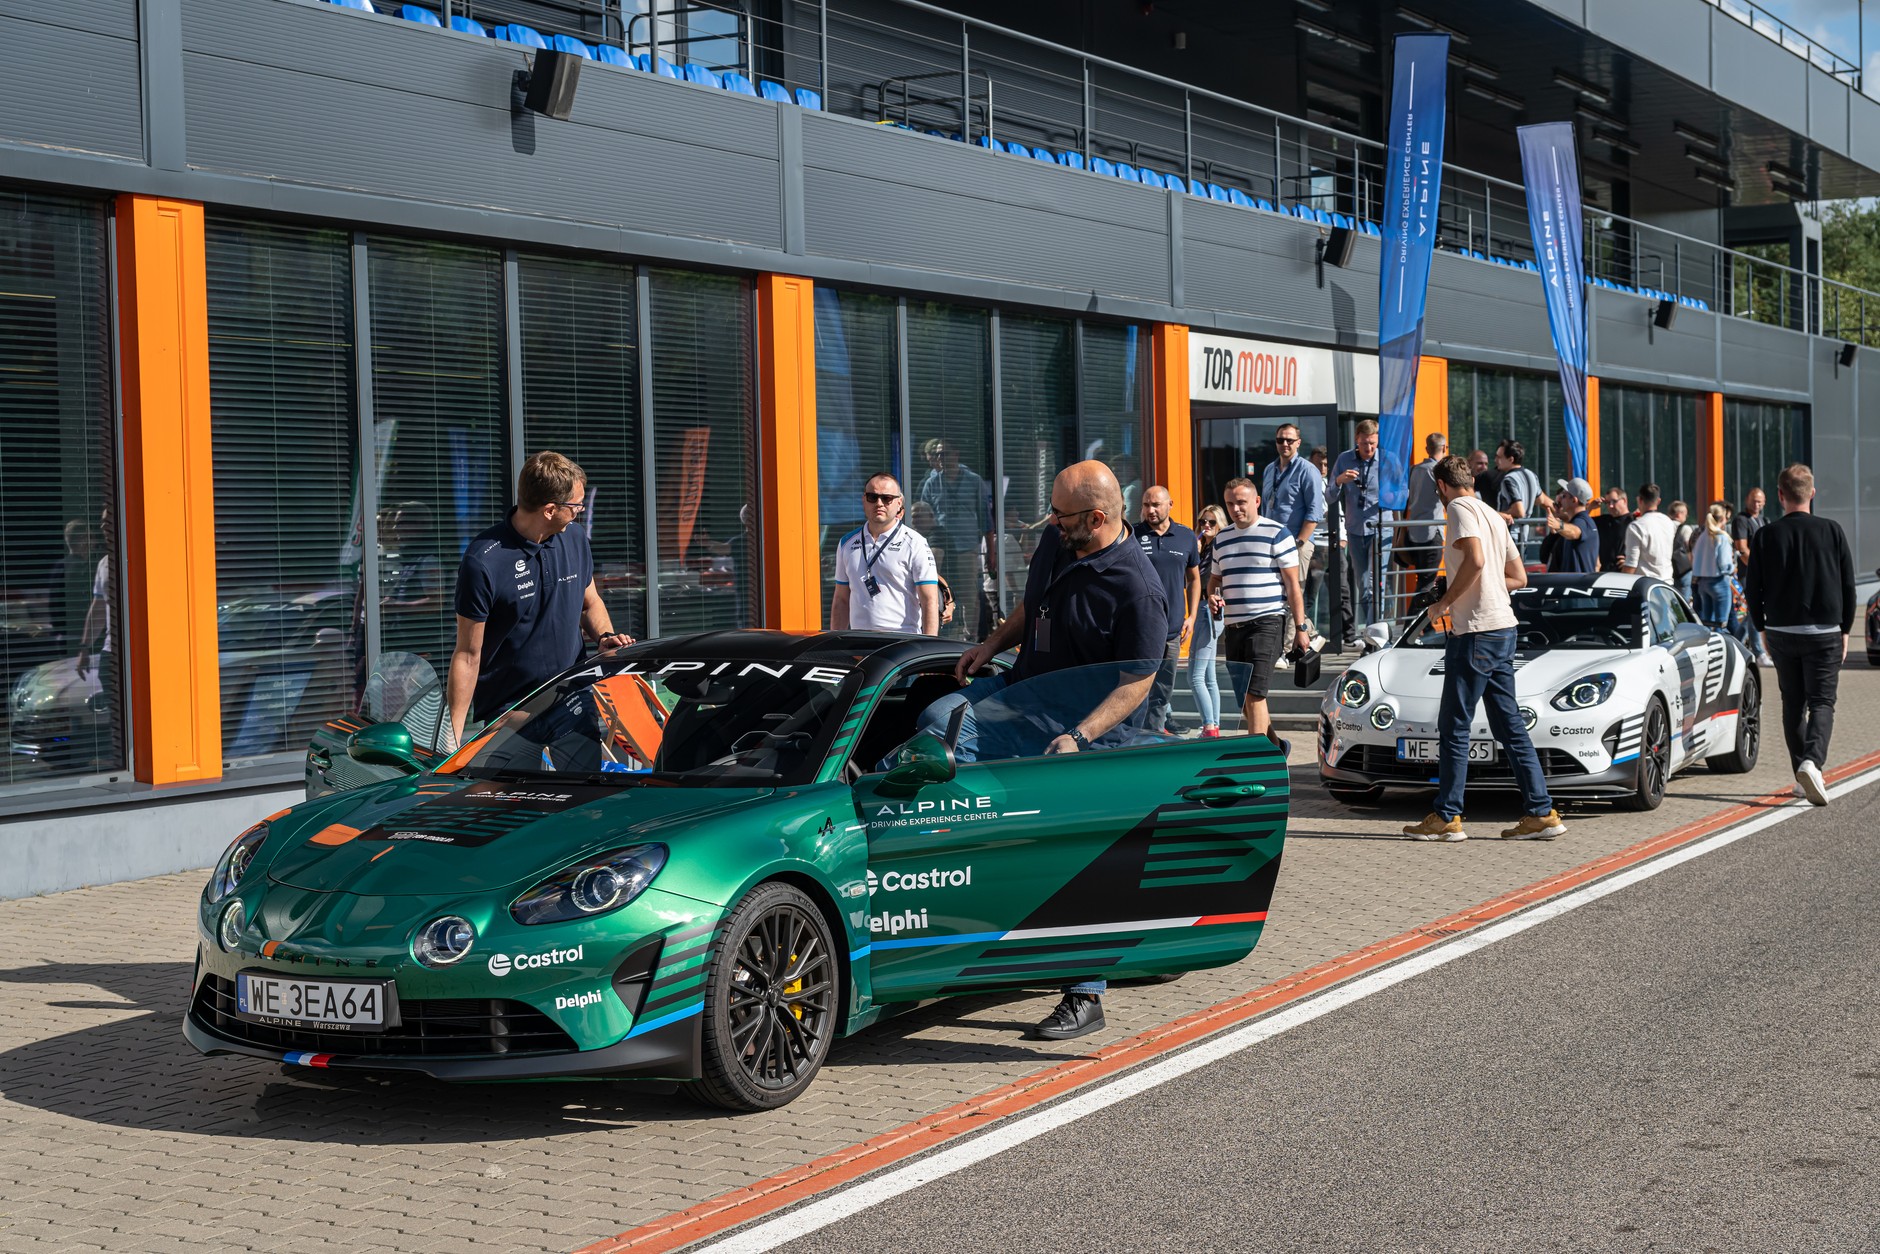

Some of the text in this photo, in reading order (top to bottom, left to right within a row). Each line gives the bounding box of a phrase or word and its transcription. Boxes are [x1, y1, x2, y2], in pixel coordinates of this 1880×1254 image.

[1555, 187, 1565, 220] CENTER
[1542, 211, 1558, 288] ALPINE
[1559, 221, 1570, 272] EXPERIENCE
[1203, 346, 1297, 396] TOR MODLIN
[514, 569, 531, 579] Castrol
[558, 573, 578, 582] ALPINE
[517, 580, 535, 591] Delphi
[1510, 587, 1630, 599] PINE
[565, 662, 850, 685] ALPINE
[1341, 721, 1363, 732] Castrol
[1562, 726, 1595, 735] Castrol
[1408, 741, 1429, 758] WE
[1578, 750, 1600, 758] Delphi
[477, 791, 573, 800] ALPINE
[876, 796, 992, 816] ALPINE
[871, 811, 998, 829] DRIVING EXPERIENCE CENTER
[882, 865, 972, 892] Castrol
[870, 908, 928, 935] elphi
[513, 944, 584, 970] Castrol
[239, 997, 247, 1007] PL
[251, 979, 376, 1020] WE 3EA64
[555, 989, 603, 1010] Delphi
[258, 1016, 302, 1027] ALPINE
[313, 1021, 351, 1031] Warszawa
